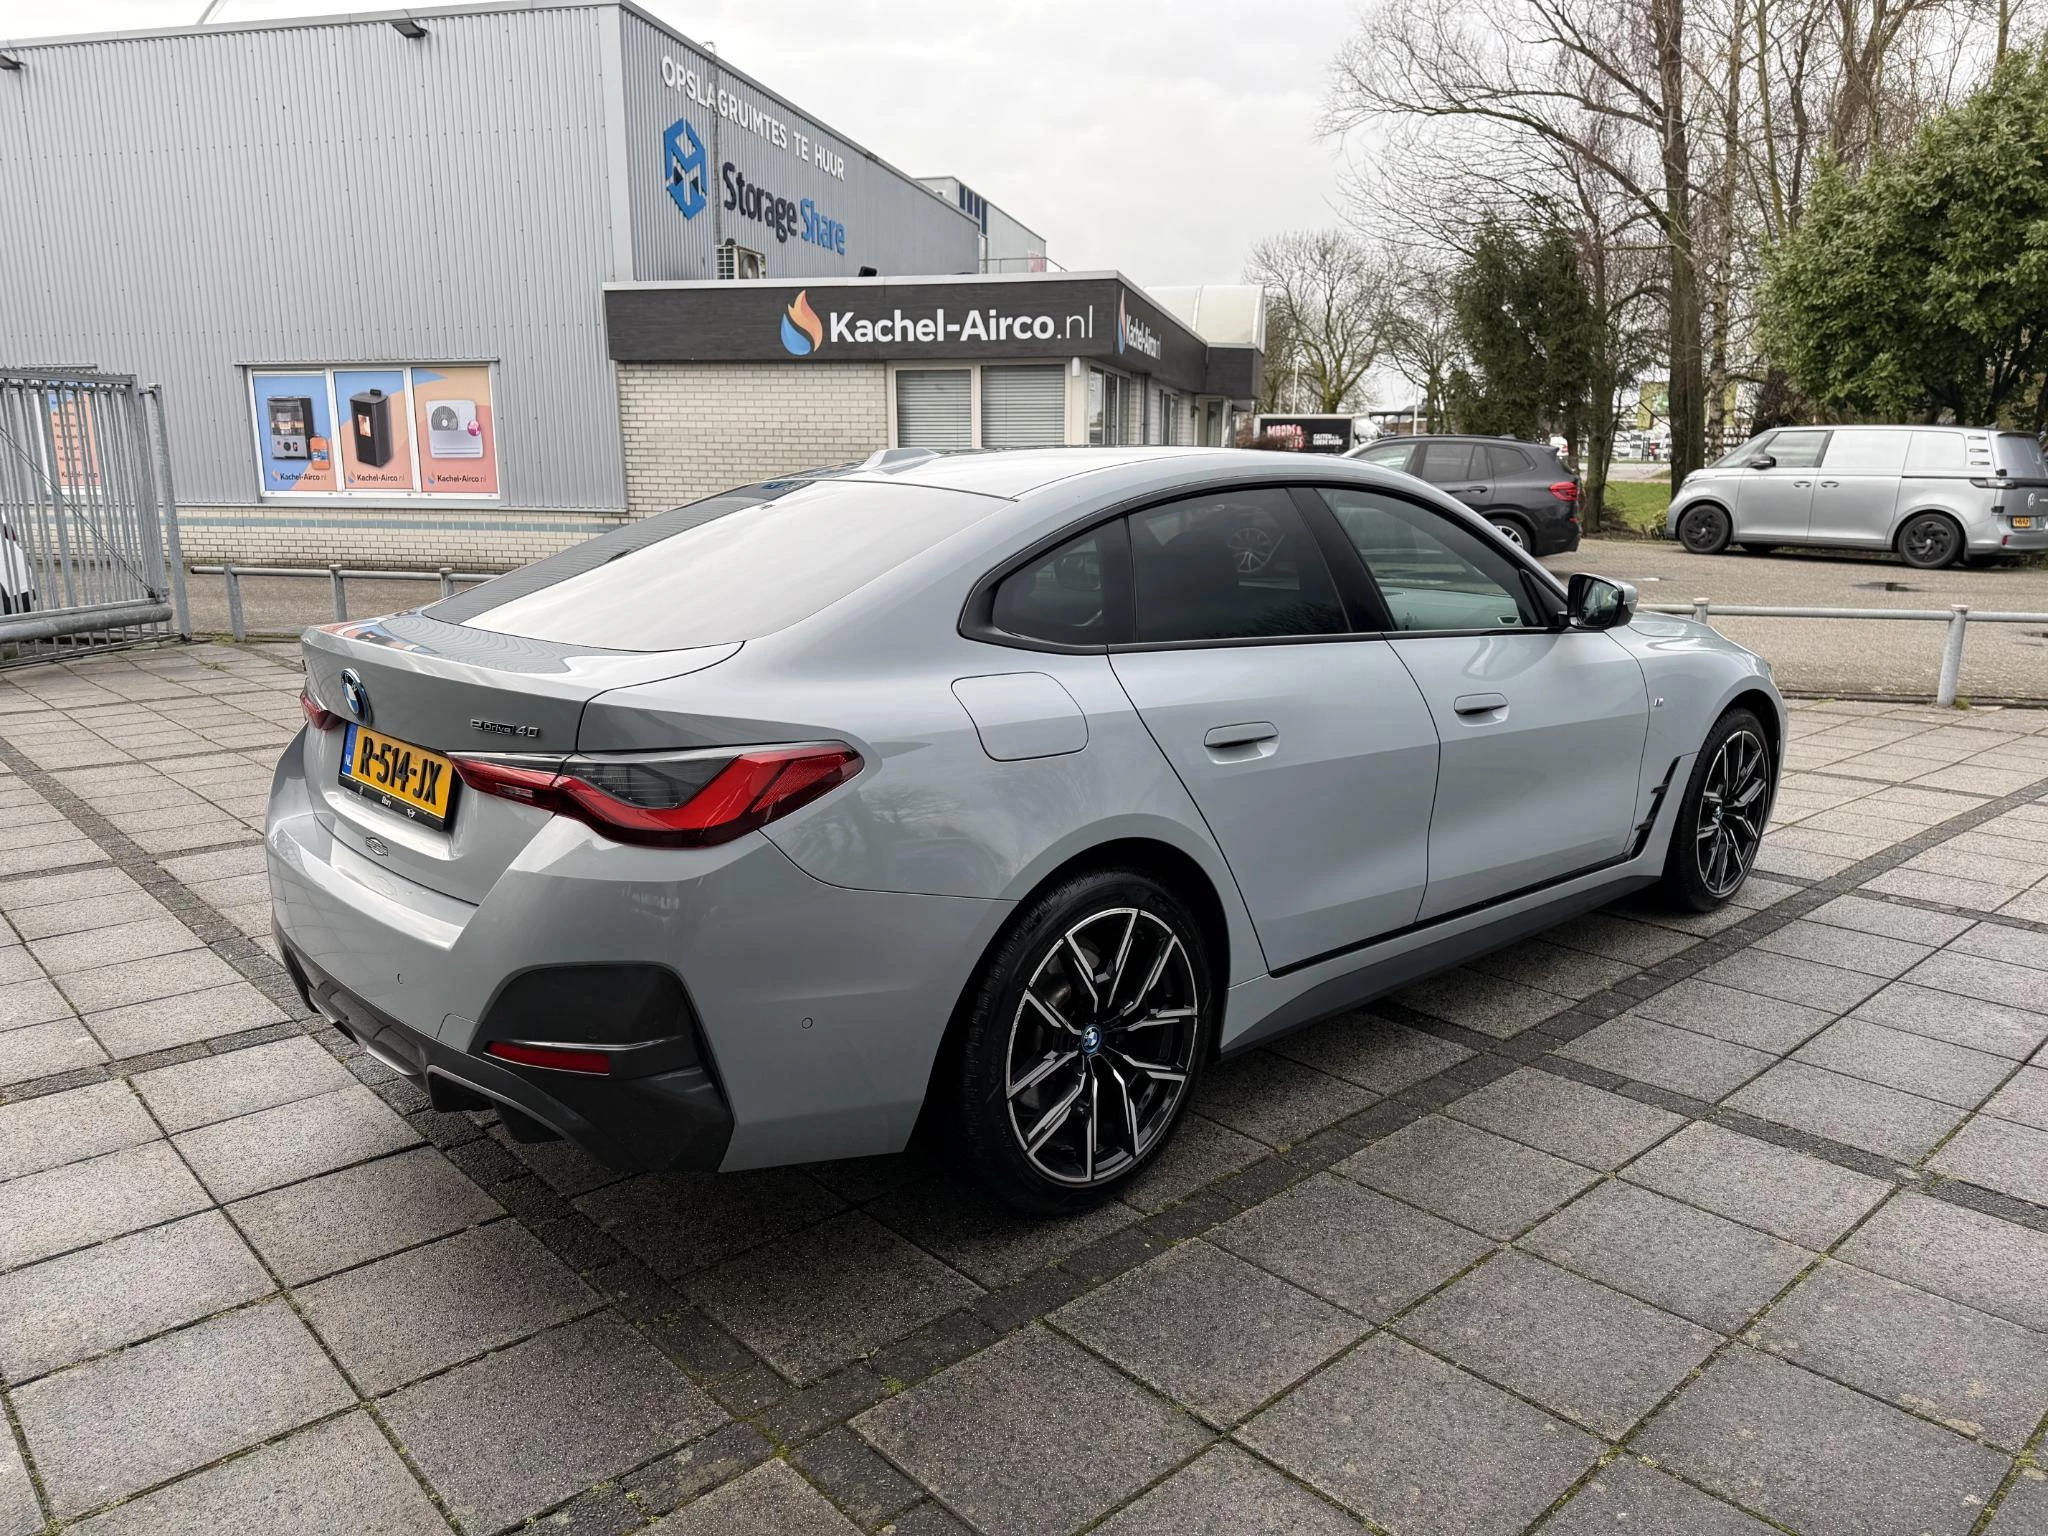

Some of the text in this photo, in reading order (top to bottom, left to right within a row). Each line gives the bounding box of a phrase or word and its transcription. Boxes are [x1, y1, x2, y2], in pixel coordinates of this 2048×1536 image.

[661, 56, 845, 181] OPSLAGRUIMTES TE HUUR
[722, 162, 846, 255] Storage Share
[831, 305, 1093, 344] Kachel-Airco.nl
[359, 735, 442, 806] R-514-JX
